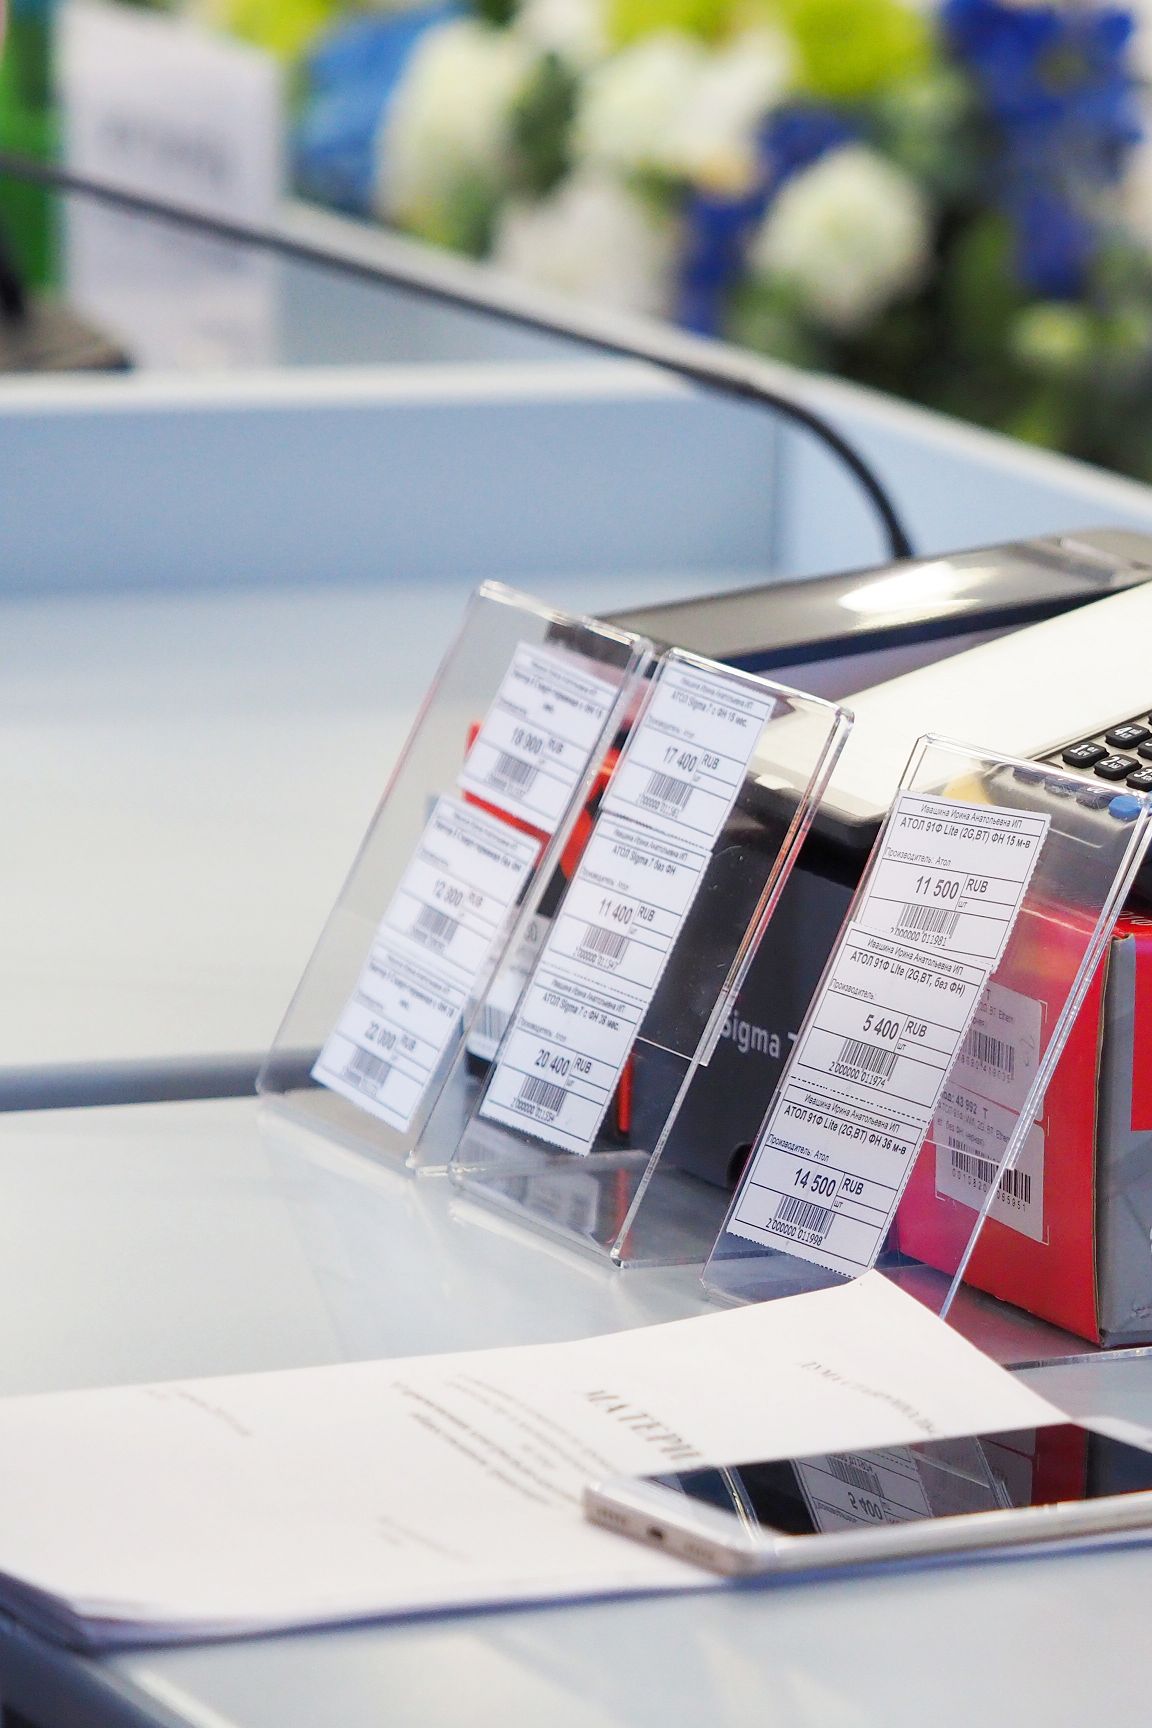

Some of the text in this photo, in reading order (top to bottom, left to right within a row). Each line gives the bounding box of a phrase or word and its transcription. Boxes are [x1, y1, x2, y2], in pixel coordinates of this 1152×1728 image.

[663, 746, 720, 772] 17 400 RUB
[921, 804, 1022, 828] Ивашина Ирина Анатольевна ИП
[900, 817, 924, 830] АТОЛ
[925, 821, 943, 833] 91Ф
[944, 823, 959, 837] Lite
[991, 831, 1005, 844] ФН
[1006, 834, 1015, 846] 15
[1016, 838, 1031, 848] м-в
[885, 847, 951, 867] Производитель: Атол
[916, 875, 988, 900] 11 500 RUB
[599, 899, 655, 925] 11 400 RUB
[867, 938, 964, 975] Ивашина Ирина Анатольевна ИП
[850, 950, 873, 966] АТОЛ
[873, 957, 890, 972] 91Ф
[890, 961, 905, 976] Lite
[934, 978, 948, 991] без
[949, 982, 966, 997] ФН)
[863, 1014, 928, 1040] 5 400 RUB
[534, 1049, 592, 1076] 20 400 RUB
[860, 1068, 886, 1087] 011974
[805, 1094, 900, 1133] Ивашина Ирина Анатольевна ИП
[784, 1104, 807, 1121] АТОЛ
[807, 1111, 823, 1126] 91Ф
[823, 1115, 839, 1132] Lite
[868, 1132, 882, 1146] ФН
[882, 1136, 892, 1149] 36
[892, 1143, 906, 1155] м-в
[768, 1133, 829, 1163] Производитель: Атол
[794, 1167, 864, 1198] 14 500 RUB
[833, 1200, 844, 1209] шт
[797, 1227, 823, 1246] 011998
